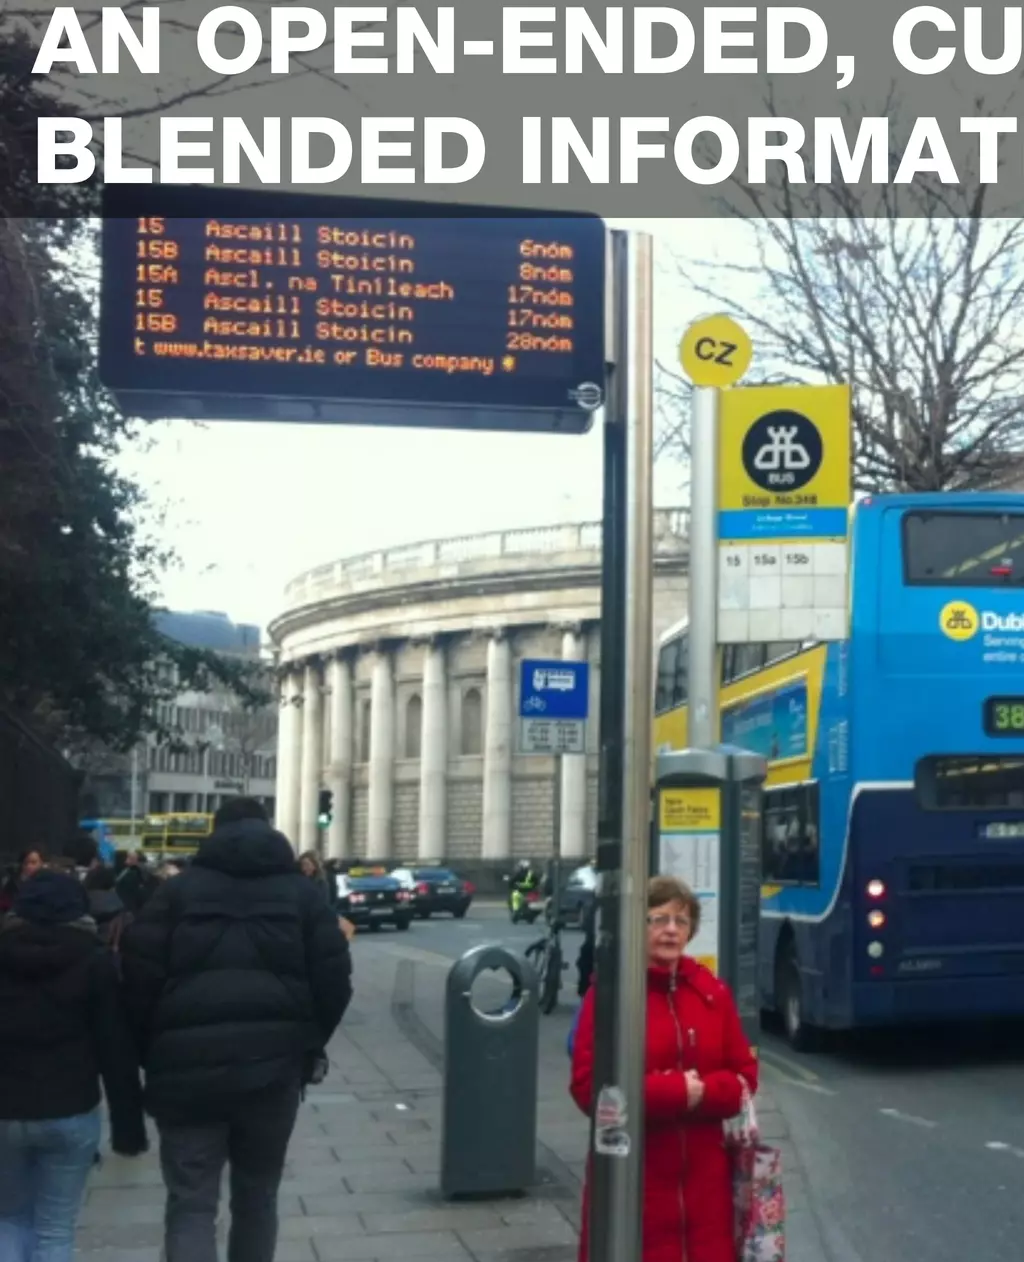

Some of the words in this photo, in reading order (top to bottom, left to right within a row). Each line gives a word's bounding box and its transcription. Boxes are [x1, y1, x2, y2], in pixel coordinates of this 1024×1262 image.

[137, 217, 165, 234] 15
[205, 219, 301, 243] Ascaill
[137, 240, 179, 260] 15B
[205, 243, 301, 267] Ascaill
[136, 264, 178, 284] 15A
[205, 268, 274, 288] Ascl.
[288, 276, 318, 292] na
[136, 289, 163, 308] 15
[204, 292, 301, 315] Ascaill
[135, 312, 177, 333] 15B
[203, 316, 300, 339] Ascaill
[334, 350, 357, 365] or
[365, 349, 403, 367] Bus
[412, 353, 494, 376] company
[694, 337, 738, 367] CZ
[768, 471, 795, 485] BUS
[726, 555, 741, 567] 15
[754, 554, 777, 566] 15a
[786, 553, 809, 565] 15b
[983, 652, 1017, 663] entire
